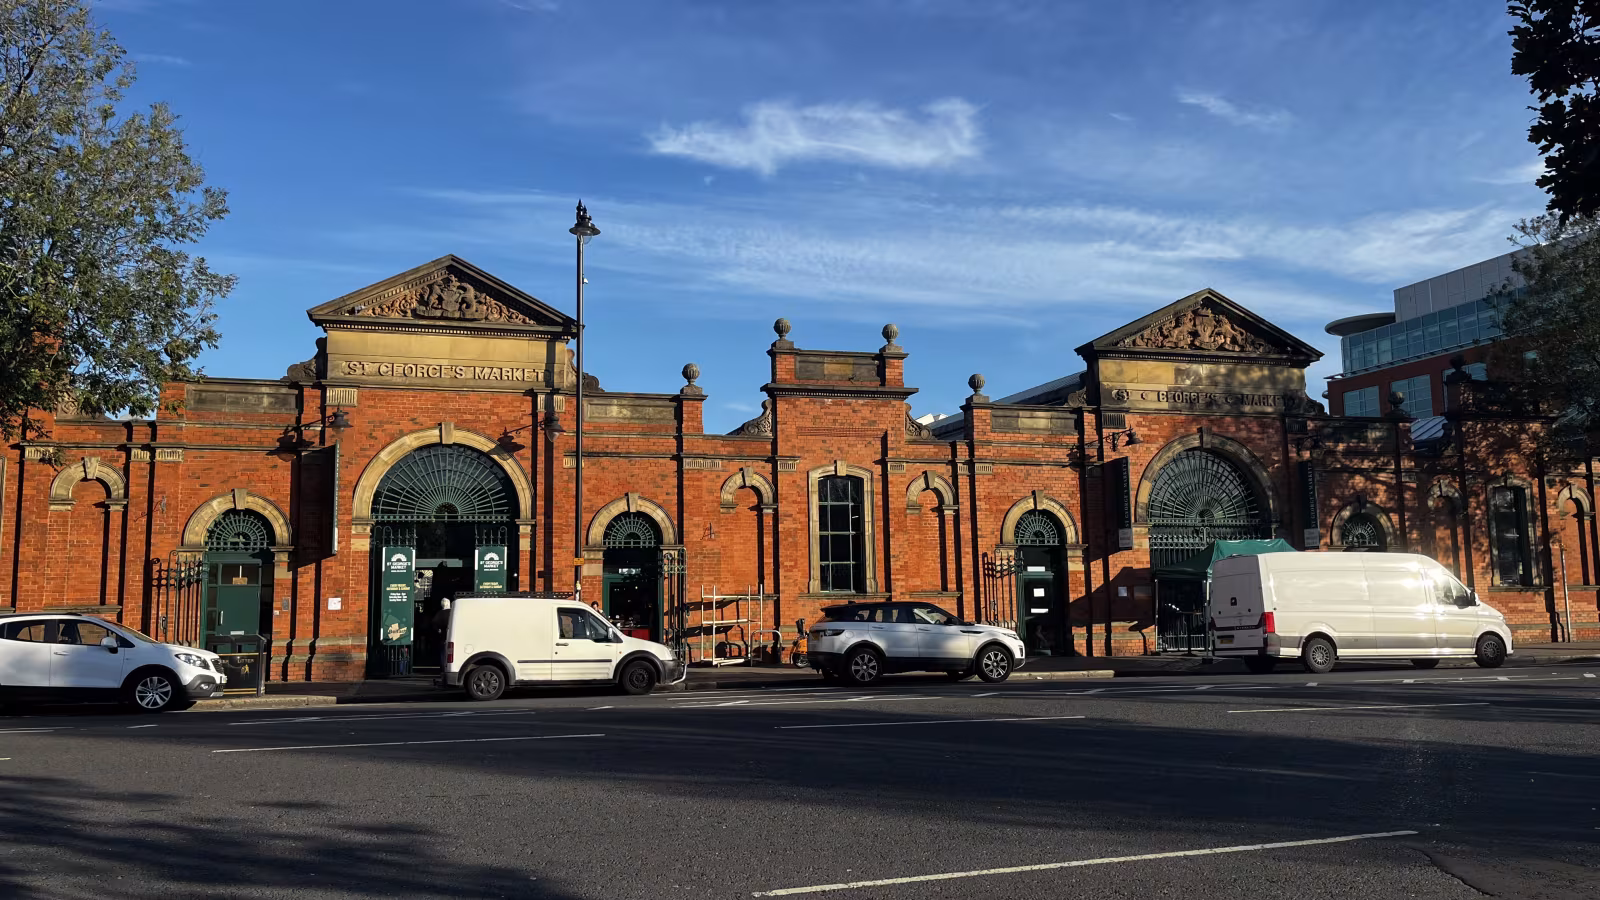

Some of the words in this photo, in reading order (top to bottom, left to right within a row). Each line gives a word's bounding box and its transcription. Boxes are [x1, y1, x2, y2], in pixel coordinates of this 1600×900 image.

[347, 361, 368, 375] ST
[378, 363, 466, 379] GEORGE'S
[474, 366, 546, 382] MARKET
